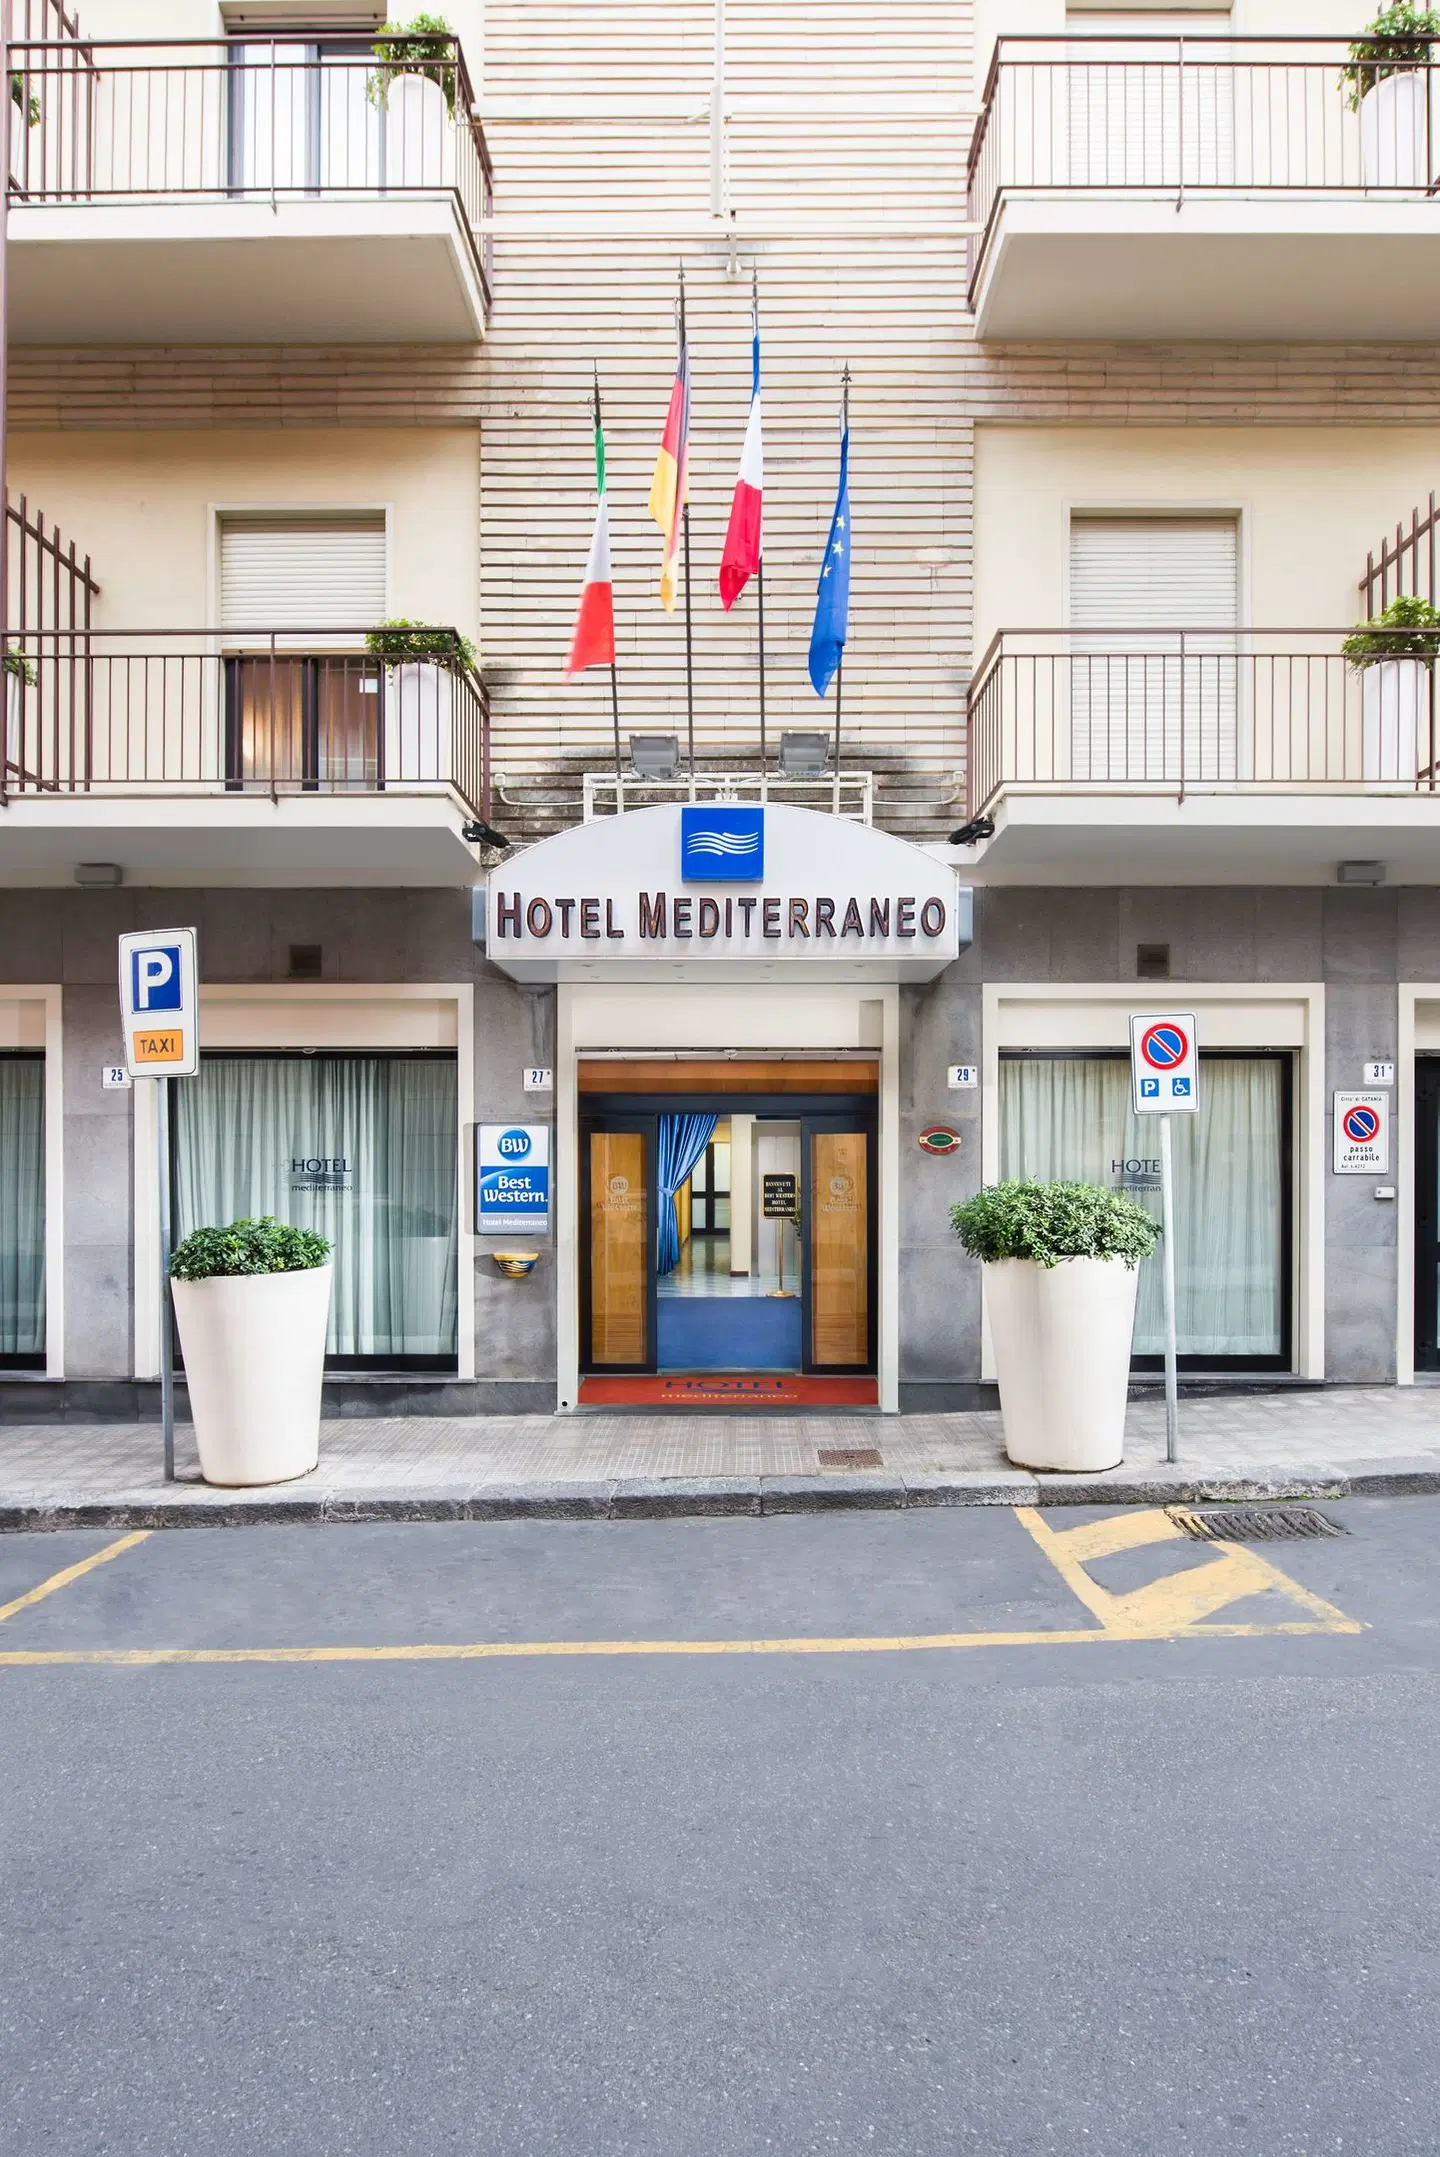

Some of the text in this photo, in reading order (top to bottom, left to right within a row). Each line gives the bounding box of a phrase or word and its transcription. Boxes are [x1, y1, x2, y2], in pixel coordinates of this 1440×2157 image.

[496, 891, 947, 939] HOTEL MEDITERRANEO
[138, 951, 173, 1009] P
[140, 1038, 175, 1054] TAXI
[111, 1069, 123, 1081] 25
[532, 1070, 544, 1083] 27
[957, 1068, 969, 1081] 29
[1373, 1065, 1385, 1077] 31
[1144, 1081, 1156, 1095] P
[501, 1138, 529, 1153] BW
[1343, 1153, 1380, 1161] carrabile
[292, 1159, 352, 1172] HOTEL
[1112, 1160, 1161, 1173] HOTE
[292, 1184, 353, 1192] mediterraneo
[498, 1175, 532, 1189] Best
